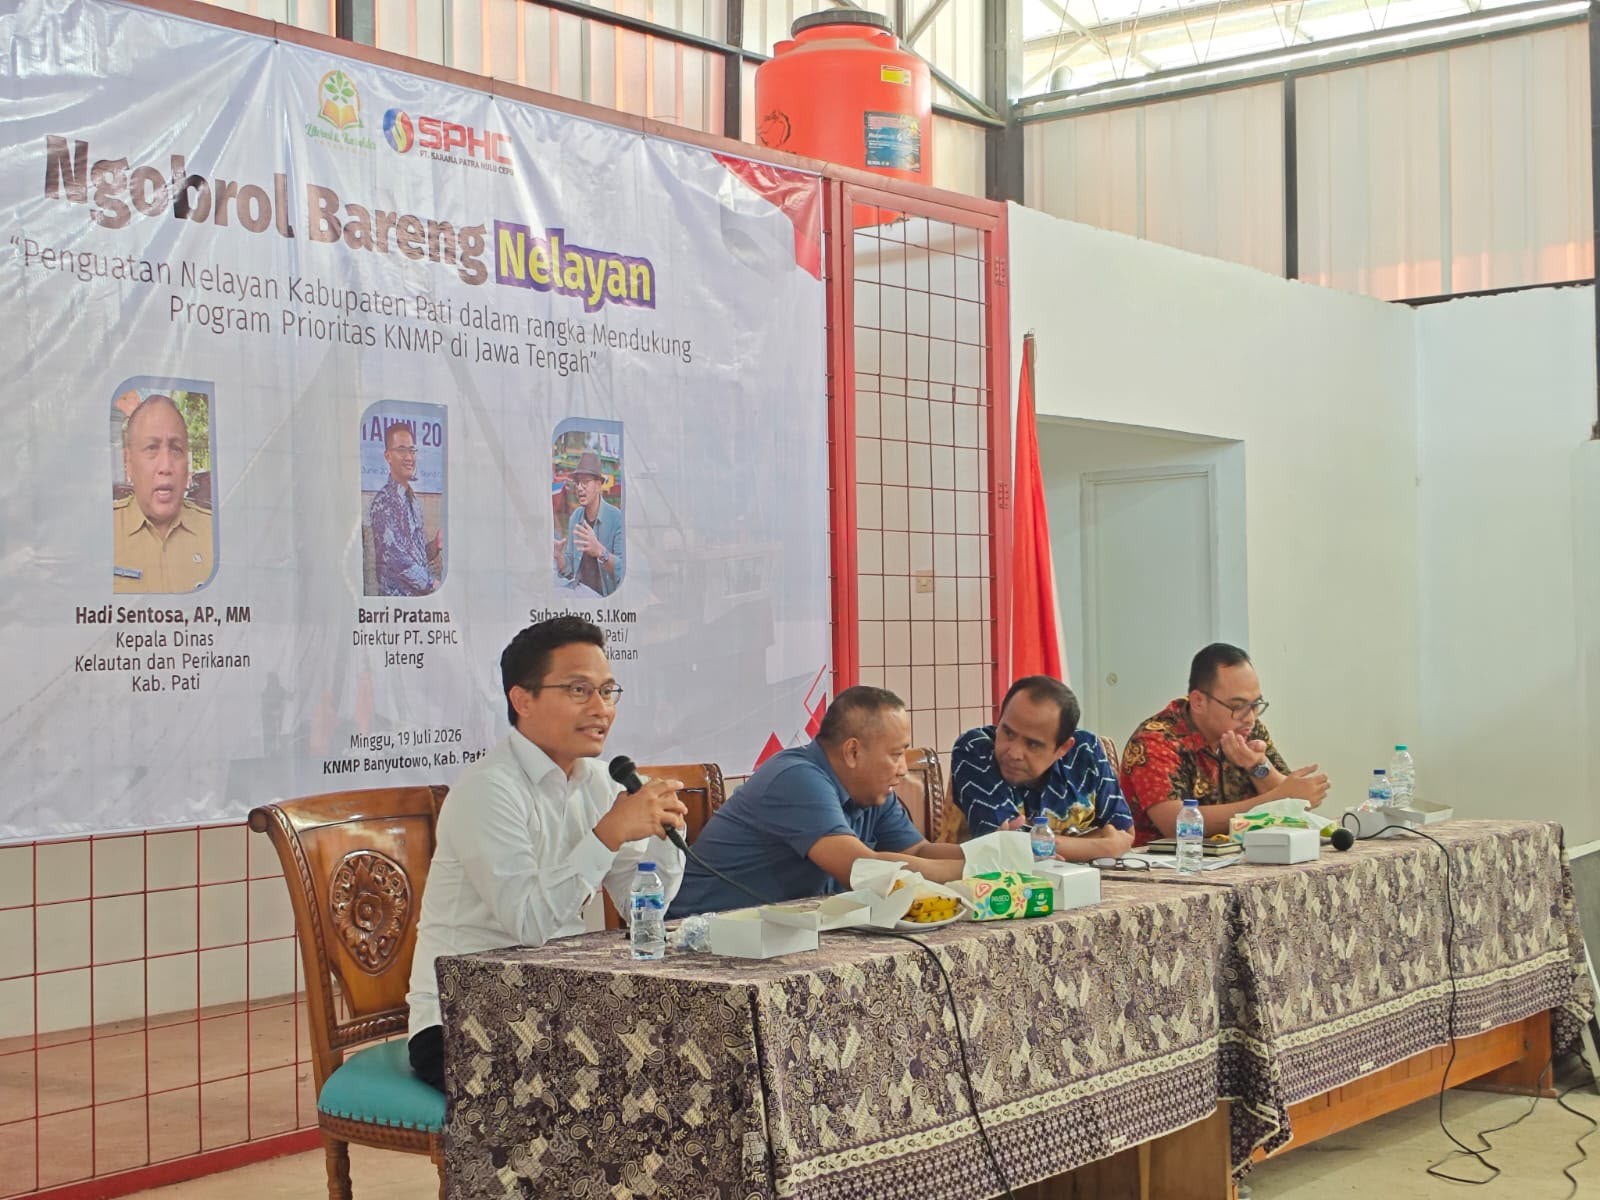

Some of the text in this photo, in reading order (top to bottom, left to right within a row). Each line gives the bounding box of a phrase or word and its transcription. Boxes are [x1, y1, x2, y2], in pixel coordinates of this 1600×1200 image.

[418, 116, 513, 165] SPHC
[459, 158, 480, 169] PATRA
[45, 135, 652, 305] Ngobrol Bareng Nelayan
[10, 236, 692, 364] “Penguatan Nelayan Kabupaten Pati dalam rangka Mendukung
[170, 295, 597, 377] Program Prioritas KNMP di Jawa Tengah”
[76, 605, 251, 626] Hadi Sentosa, AP., MM
[358, 606, 450, 623] Barri Pratama
[596, 608, 637, 623] S.I.Kom
[116, 630, 214, 651] Kepala Dinas
[353, 629, 458, 646] Direktur PT. SPHC
[605, 628, 629, 643] Pati/
[75, 651, 251, 672] Kelautan dan Perikanan
[384, 650, 425, 669] Jateng
[606, 646, 639, 660] ikanan
[132, 673, 200, 692] Kab. Pati
[350, 728, 462, 751] Minggu, 19 Juli 2026
[323, 759, 361, 774] KNMP
[364, 756, 432, 773] Banyutowo,
[434, 752, 459, 766] Kab.
